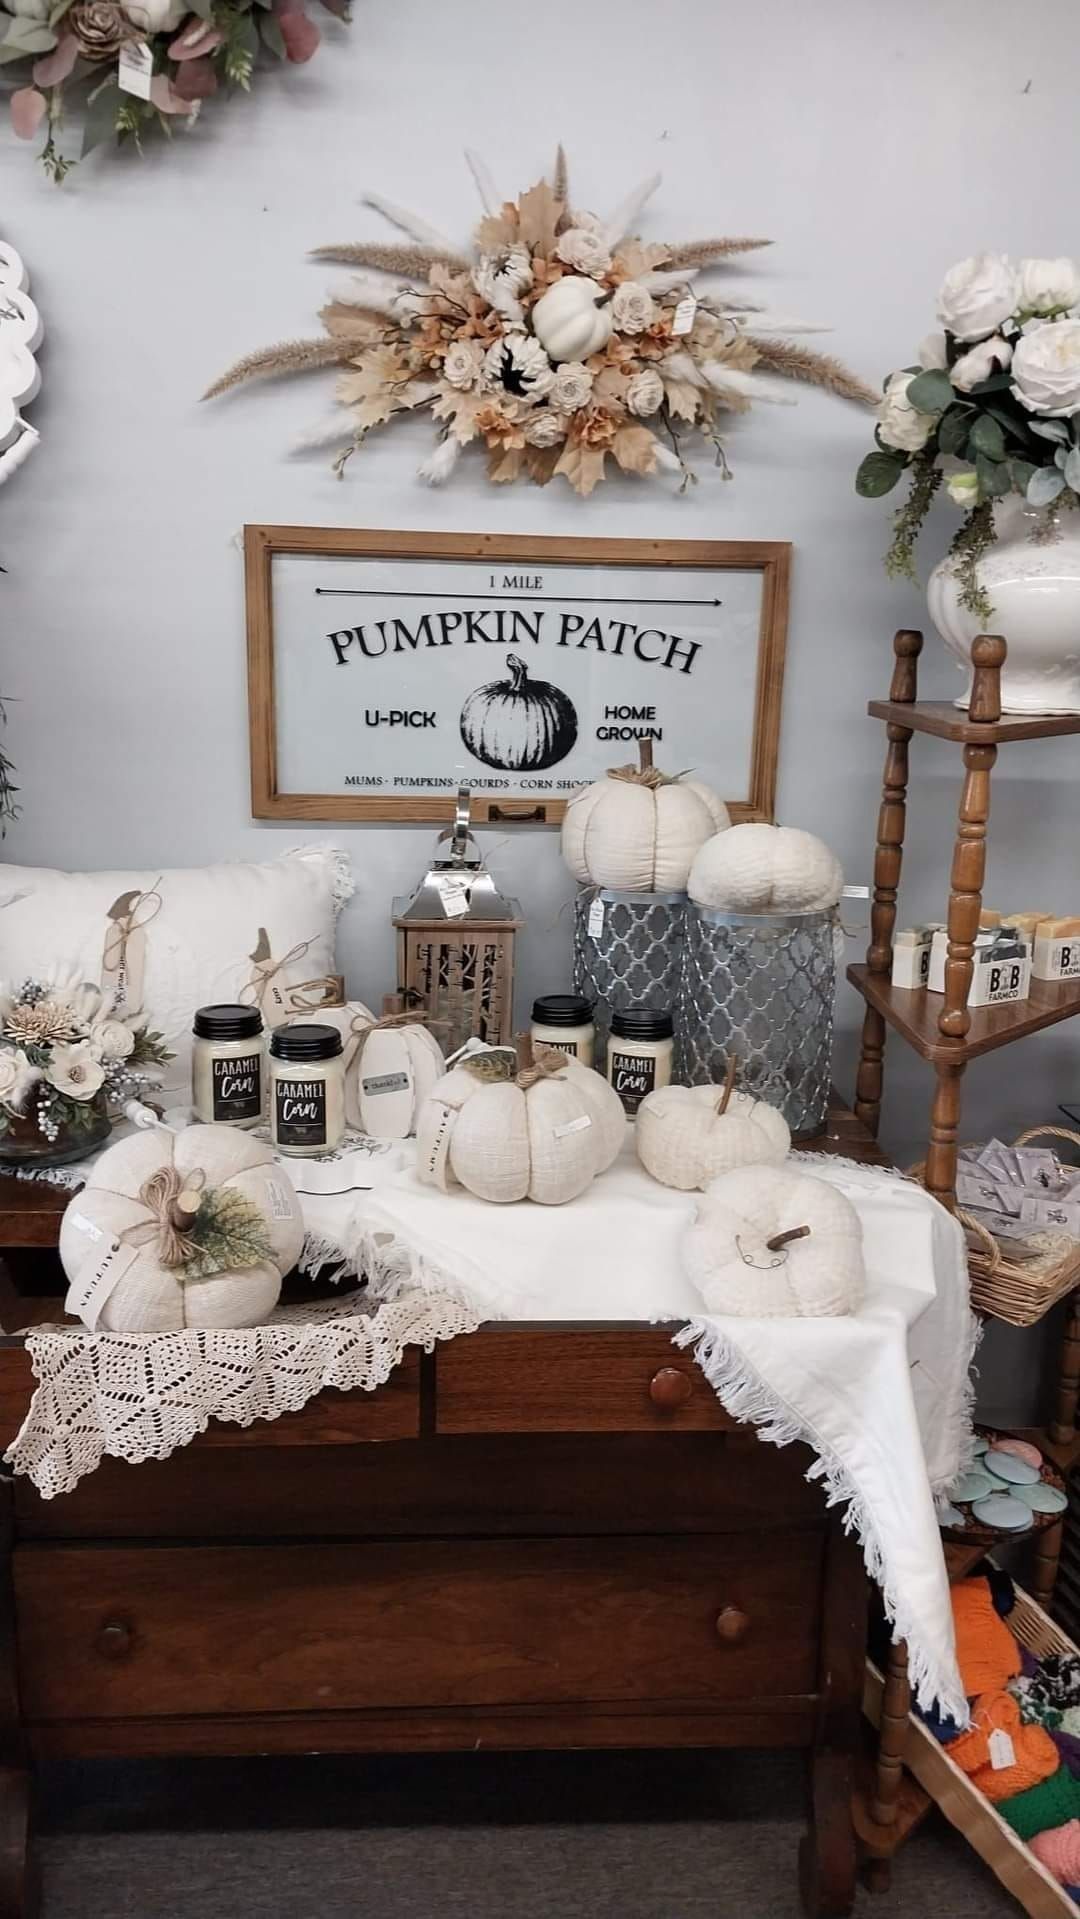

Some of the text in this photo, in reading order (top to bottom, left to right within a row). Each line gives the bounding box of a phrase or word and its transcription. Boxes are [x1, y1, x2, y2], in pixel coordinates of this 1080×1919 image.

[502, 576, 543, 589] MILE
[327, 610, 703, 674] PUMPKIN PATCH
[365, 709, 437, 728] U-PICK
[604, 705, 656, 720] HOME
[596, 726, 663, 741] GROWN
[344, 775, 383, 786] MUMS
[393, 777, 454, 788] PUMPKINS
[460, 779, 509, 789] GOURDS
[519, 779, 554, 789] CORN
[214, 1057, 259, 1076] CARAMEL
[613, 1055, 653, 1073] CARAMEL
[221, 1076, 255, 1098] Corn
[276, 1082, 324, 1098] CARAMEL
[616, 1071, 648, 1092] Corn
[283, 1099, 318, 1121] Corn
